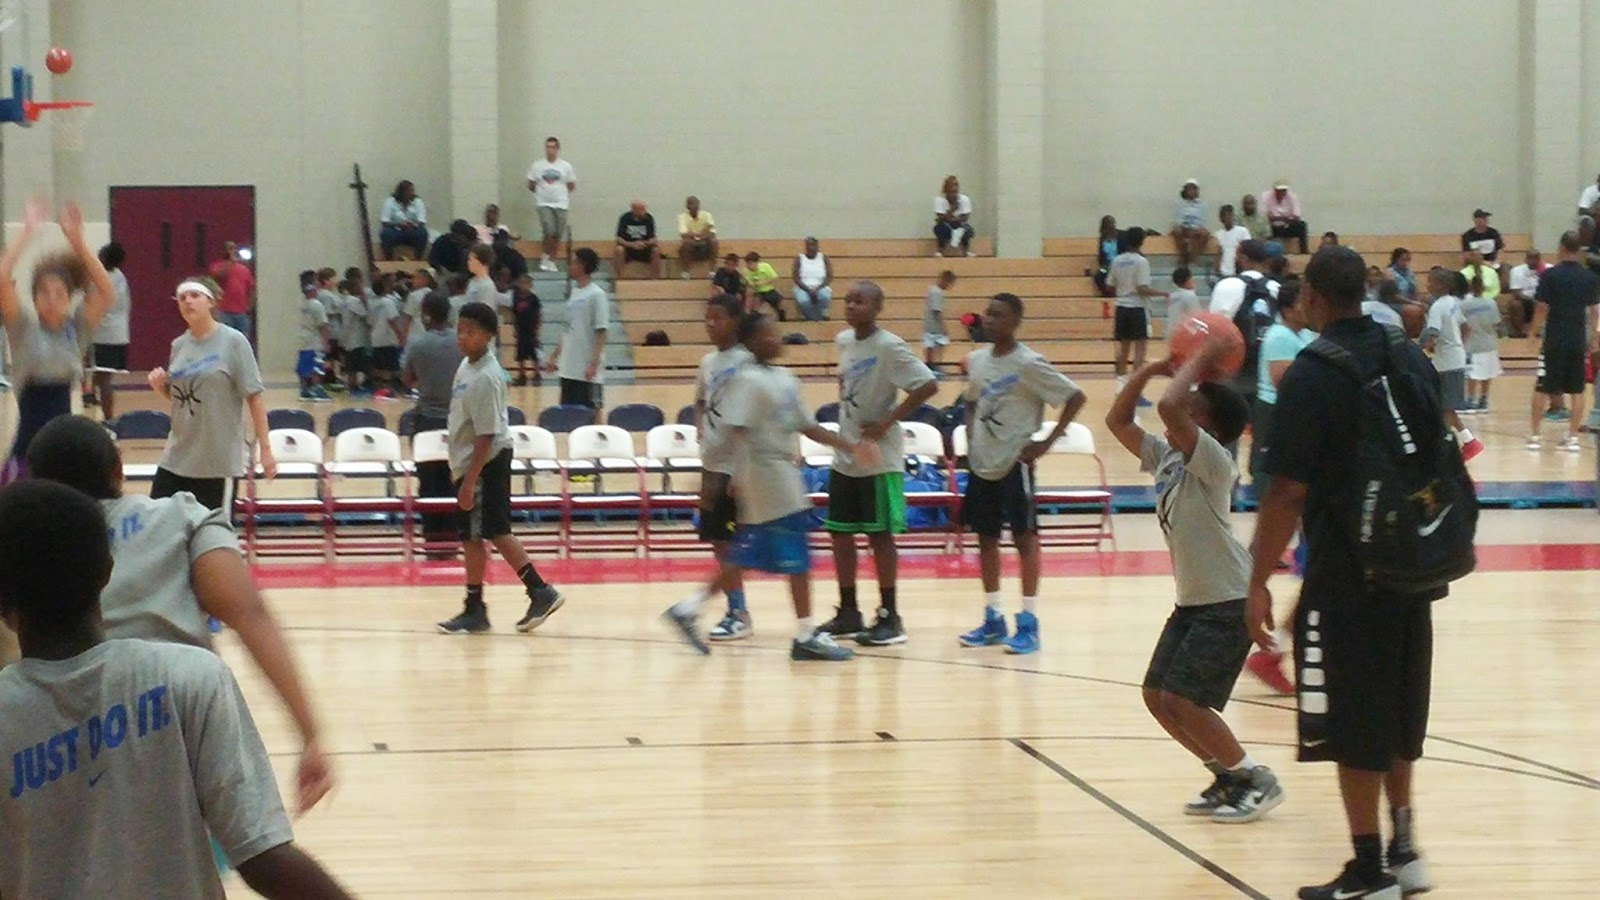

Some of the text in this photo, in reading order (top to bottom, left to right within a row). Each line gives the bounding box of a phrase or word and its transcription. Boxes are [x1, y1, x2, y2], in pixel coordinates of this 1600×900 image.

[9, 685, 171, 798] JUST DO IT.
